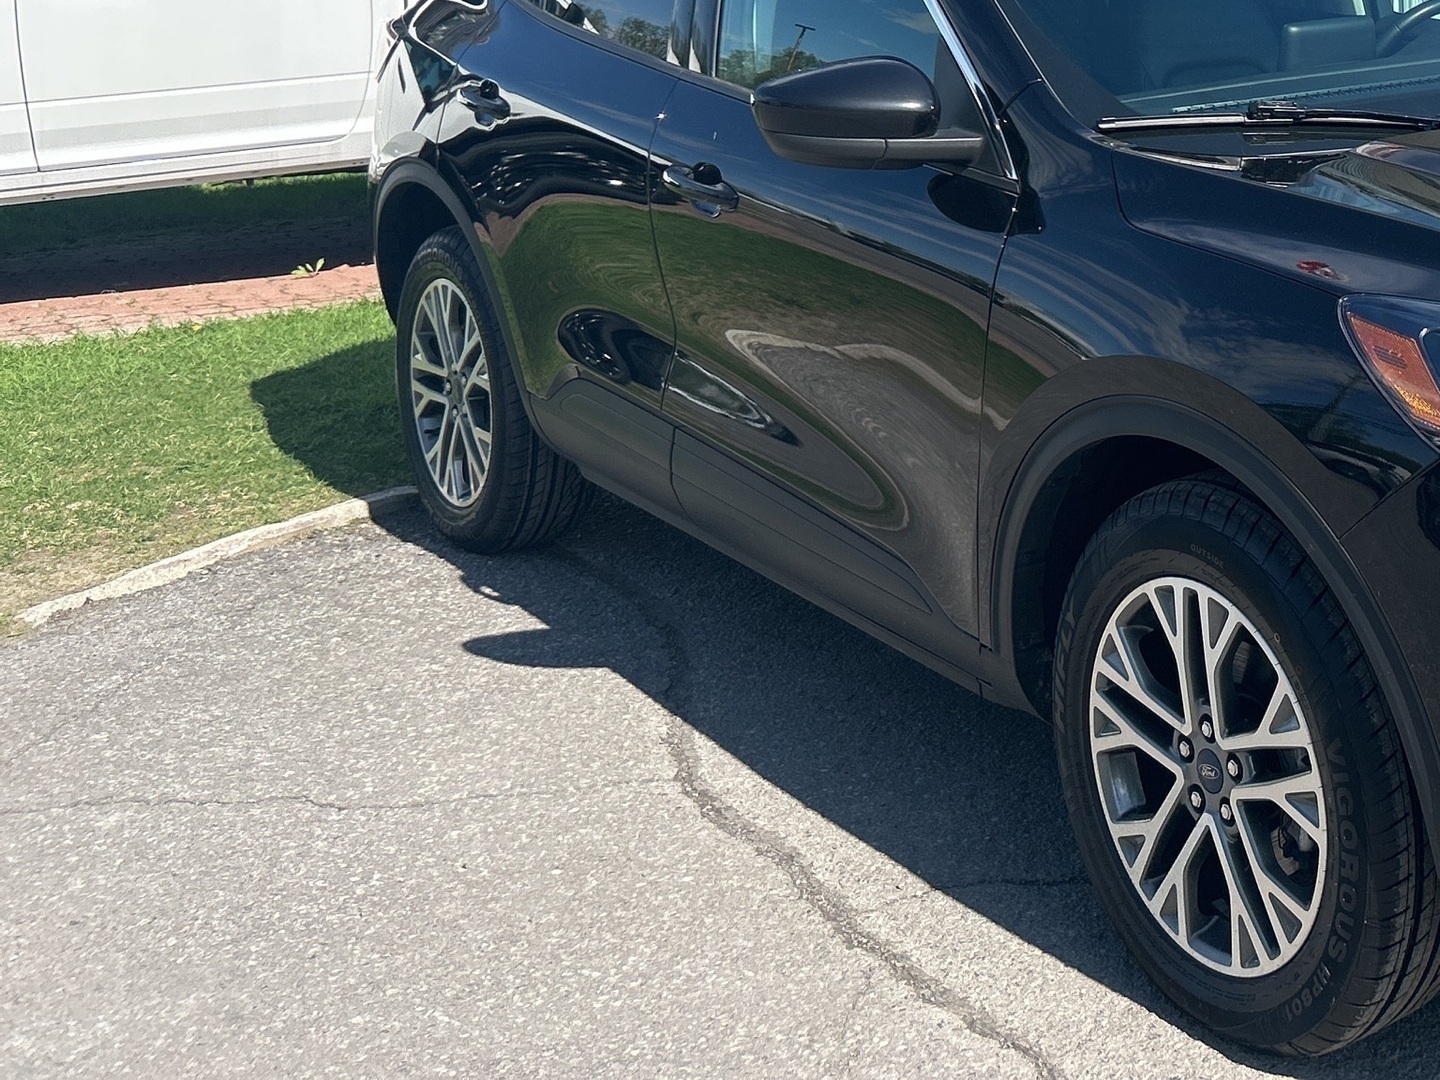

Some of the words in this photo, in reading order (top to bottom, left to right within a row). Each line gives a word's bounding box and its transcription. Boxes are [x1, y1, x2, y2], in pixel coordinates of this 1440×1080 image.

[1190, 543, 1226, 570] OUTSIDE
[1325, 736, 1360, 963] VIGOROUS
[1284, 961, 1332, 1022] HP801
